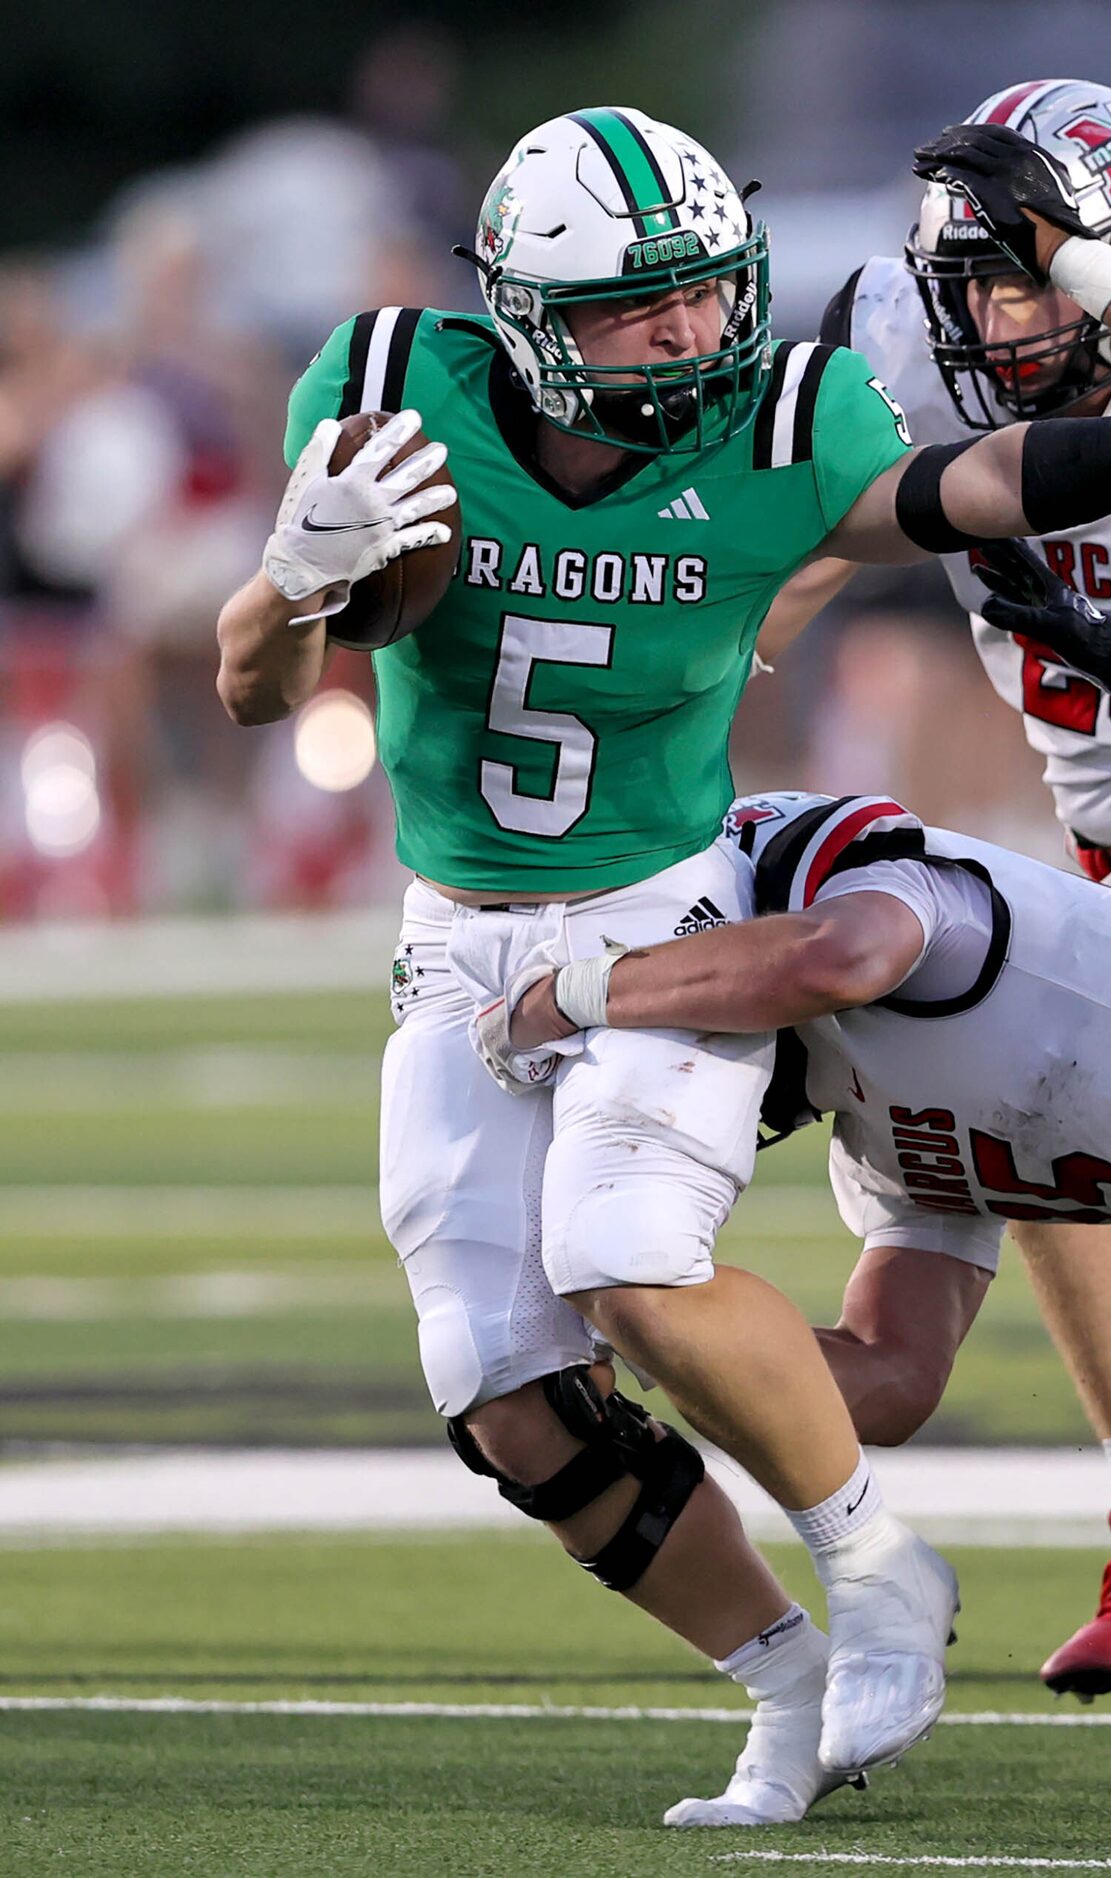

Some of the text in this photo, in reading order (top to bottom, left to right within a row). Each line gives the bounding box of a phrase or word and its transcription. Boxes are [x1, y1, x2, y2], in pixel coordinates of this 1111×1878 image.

[942, 223, 989, 240] Ridde
[627, 232, 700, 268] 76092
[453, 536, 707, 603] RAGONS
[480, 613, 614, 839] 5
[674, 917, 731, 936] adida
